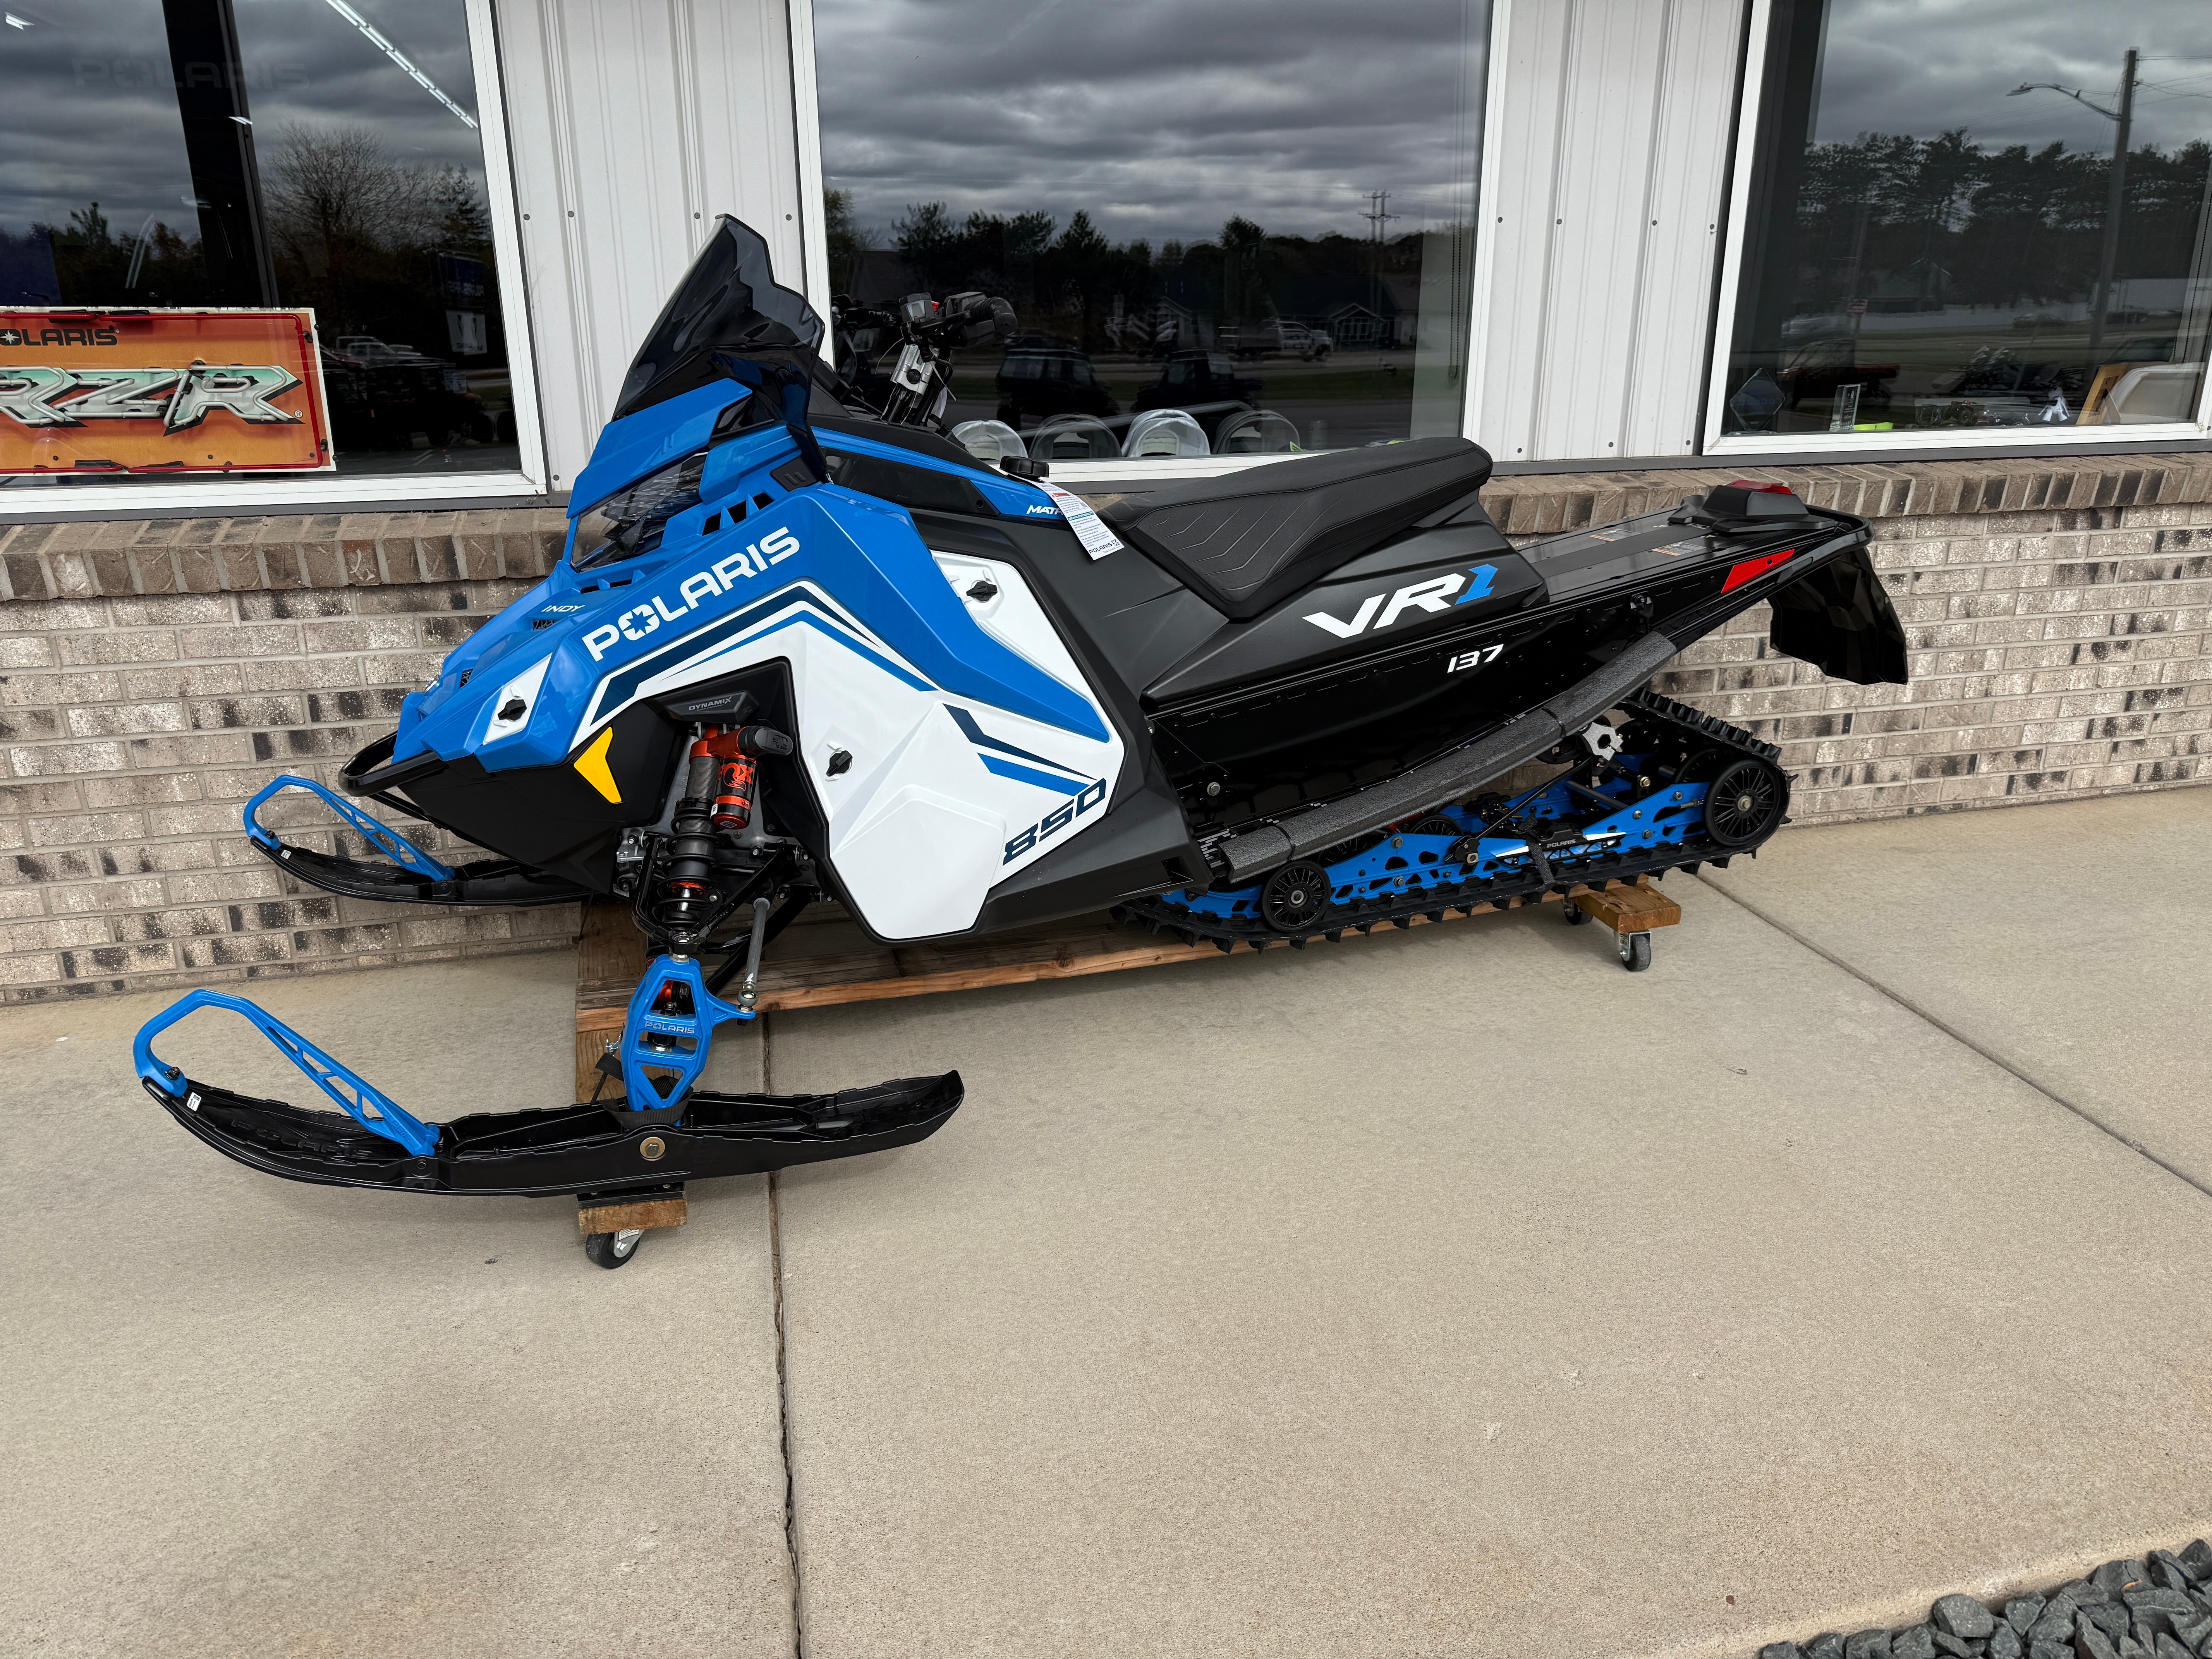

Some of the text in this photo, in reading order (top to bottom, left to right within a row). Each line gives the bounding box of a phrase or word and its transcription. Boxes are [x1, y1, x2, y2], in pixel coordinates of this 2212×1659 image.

[1089, 543, 1113, 554] POLARIS
[582, 526, 800, 661] POLARIS
[1302, 564, 1498, 638] VR1
[1447, 644, 1504, 673] 137
[689, 696, 732, 711] DYNAMIX
[1003, 778, 1107, 866] 850
[1547, 839, 1576, 848] POLARIS
[645, 1021, 695, 1034] POLARIS
[231, 1118, 373, 1158] POLARIS
[376, 1103, 411, 1141] POLARIS
